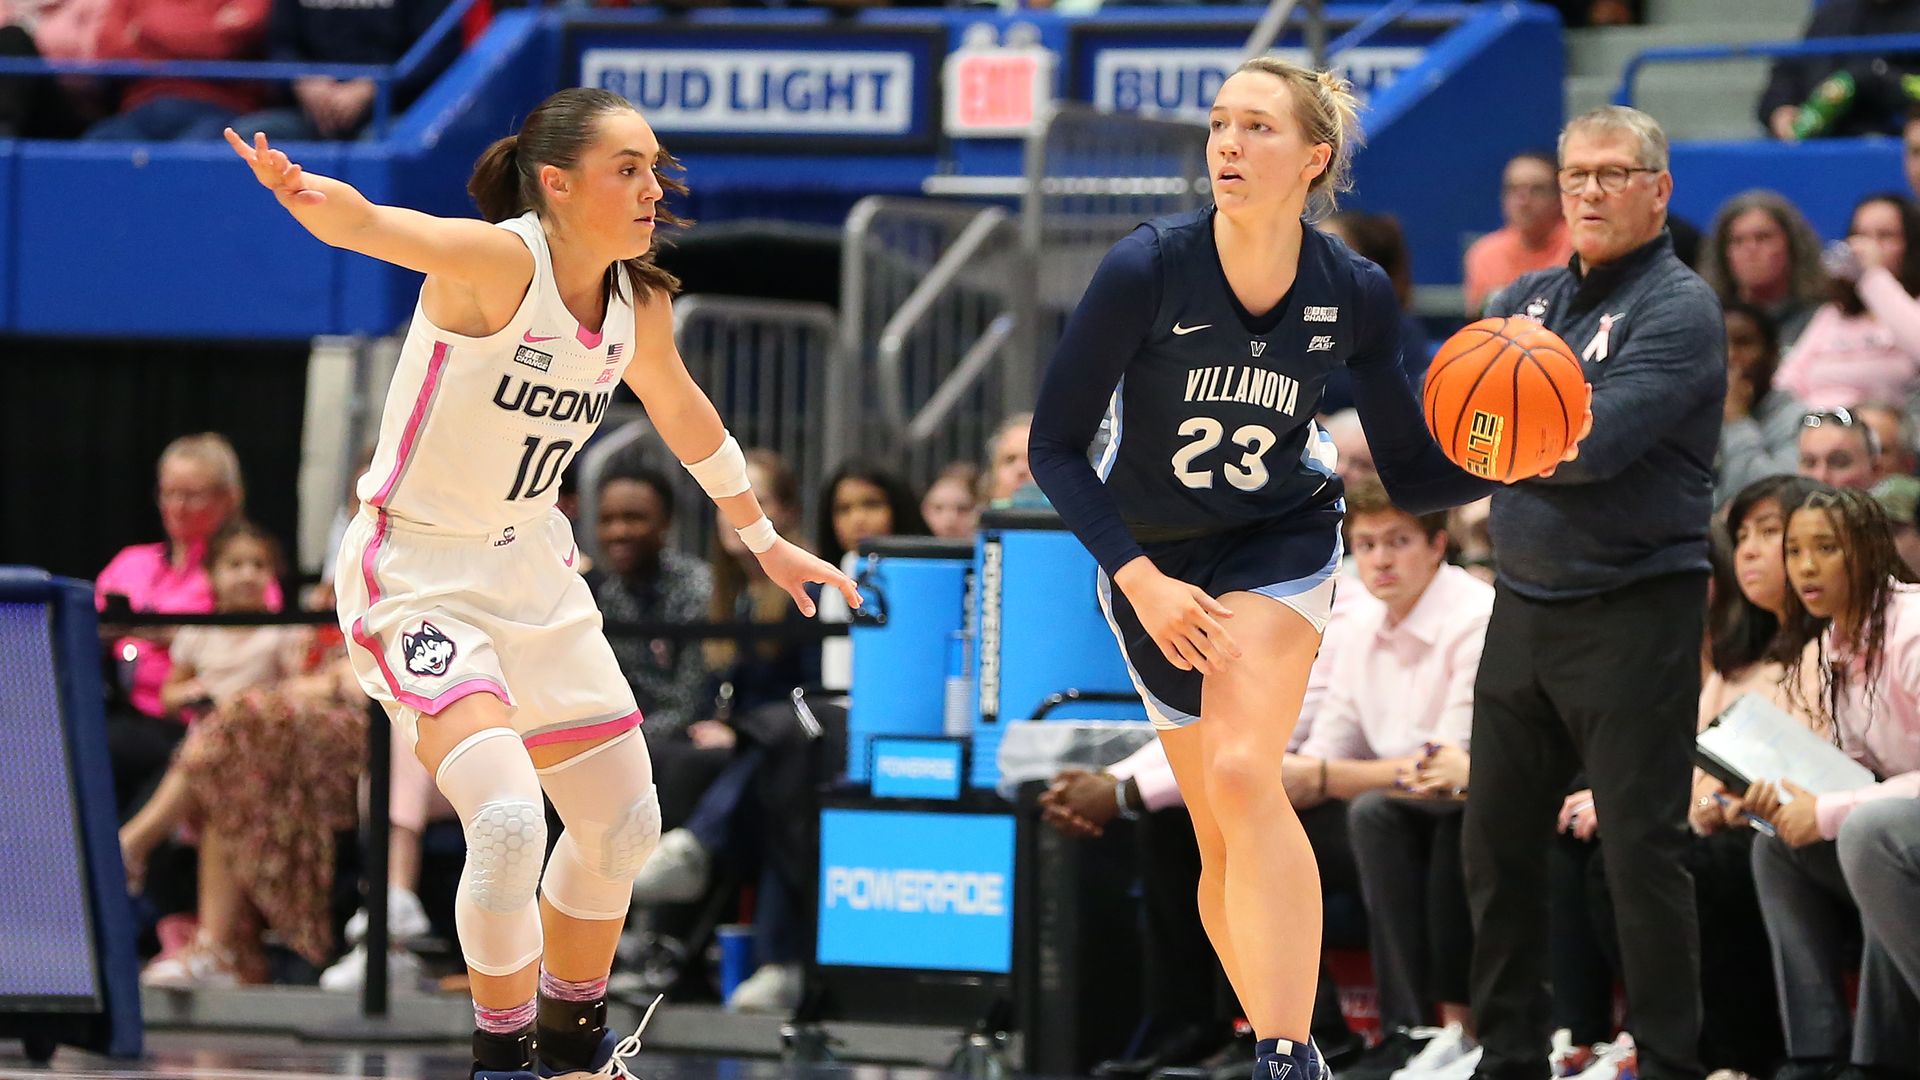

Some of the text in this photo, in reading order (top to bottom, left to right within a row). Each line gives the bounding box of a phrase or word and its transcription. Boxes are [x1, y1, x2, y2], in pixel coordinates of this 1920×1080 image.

[598, 67, 892, 114] BUD LIGHT
[959, 58, 1037, 127] EXIT
[1303, 314, 1337, 323] CHANGE
[1312, 335, 1331, 343] BIG
[515, 355, 549, 371] CHANGE
[1183, 365, 1300, 417] VILLANOVA
[502, 434, 573, 501] 10
[1170, 416, 1277, 492] 23
[1465, 409, 1499, 476] ELITE
[979, 541, 1002, 716] POWERADE
[876, 756, 956, 780] POWERADE
[824, 865, 1006, 917] POWERADE
